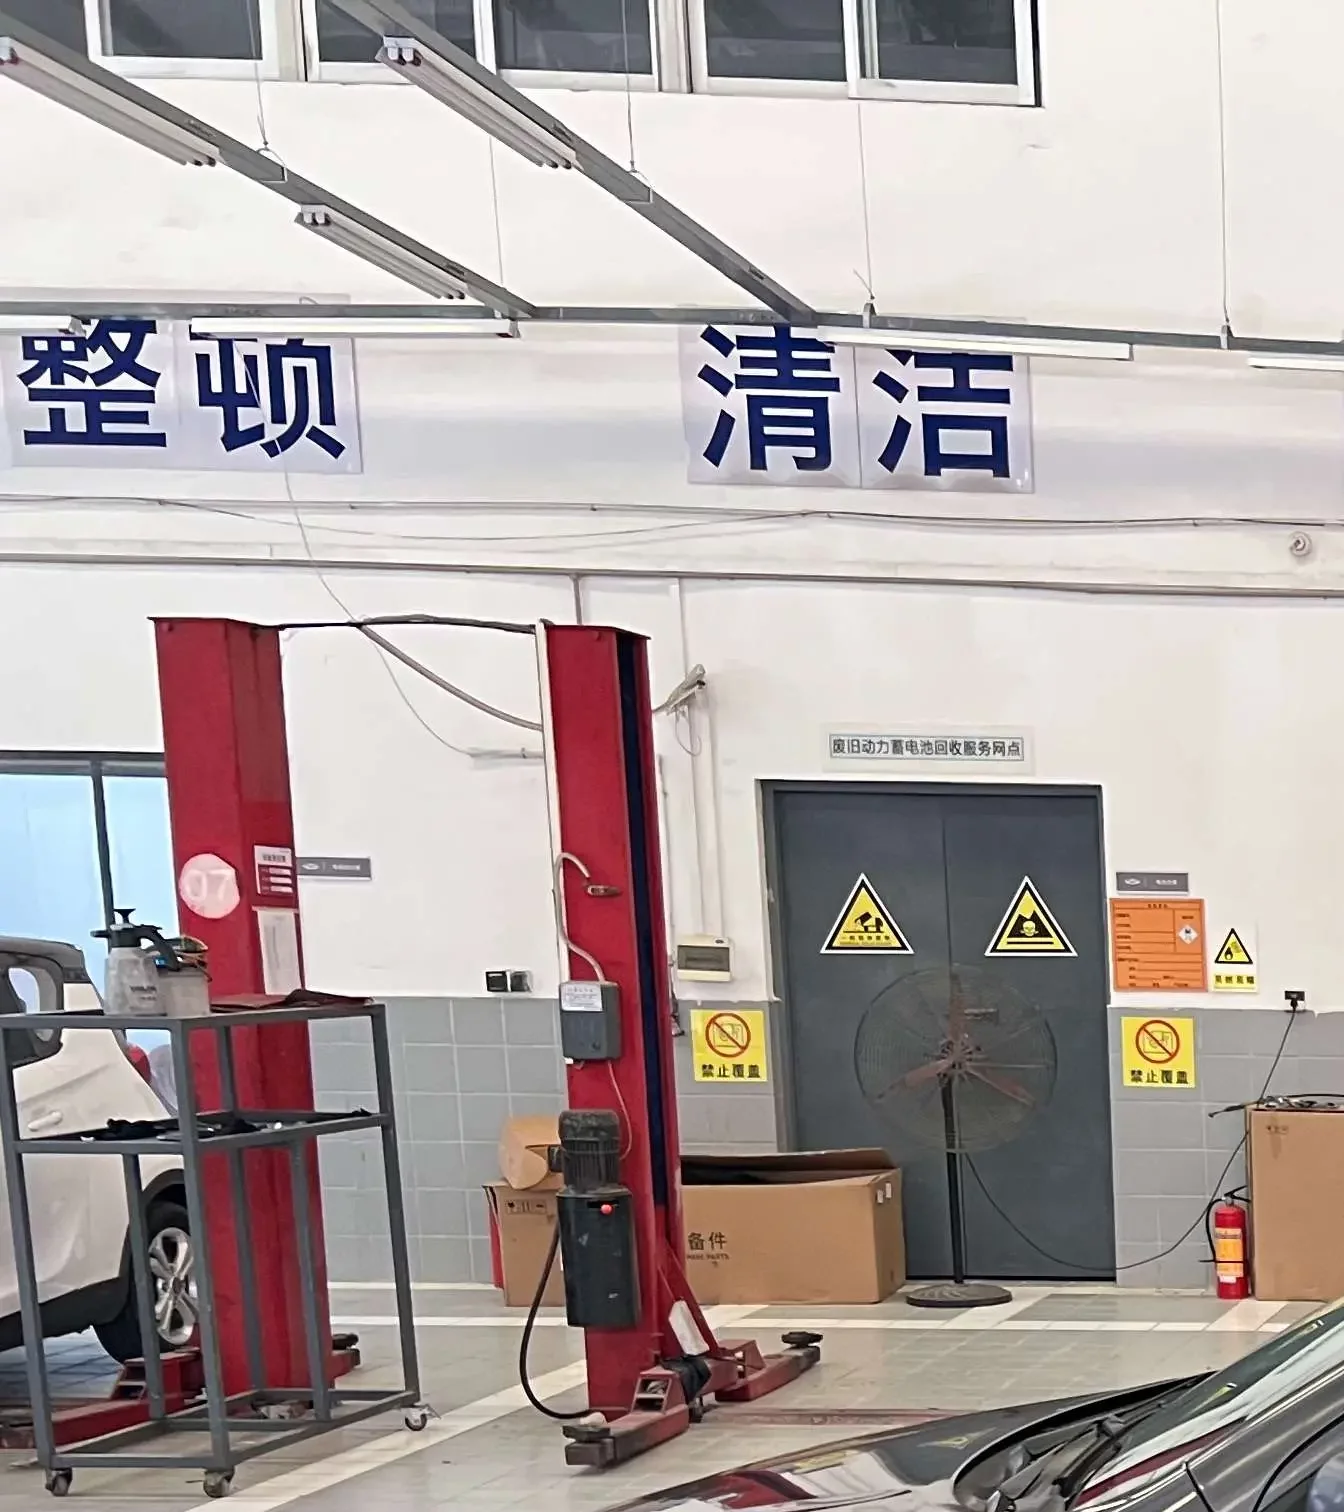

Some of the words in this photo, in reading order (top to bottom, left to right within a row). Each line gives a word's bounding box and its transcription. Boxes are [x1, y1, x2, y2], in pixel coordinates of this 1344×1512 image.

[17, 320, 345, 459] 整顿
[698, 323, 1013, 478] 清洁
[832, 738, 1021, 758] 废旧动力蓄电池回收服务网点
[184, 868, 236, 901] 07
[701, 1063, 761, 1079] 禁止覆盖
[1130, 1069, 1189, 1085] 禁止覆盖
[687, 1231, 728, 1251] 备件
